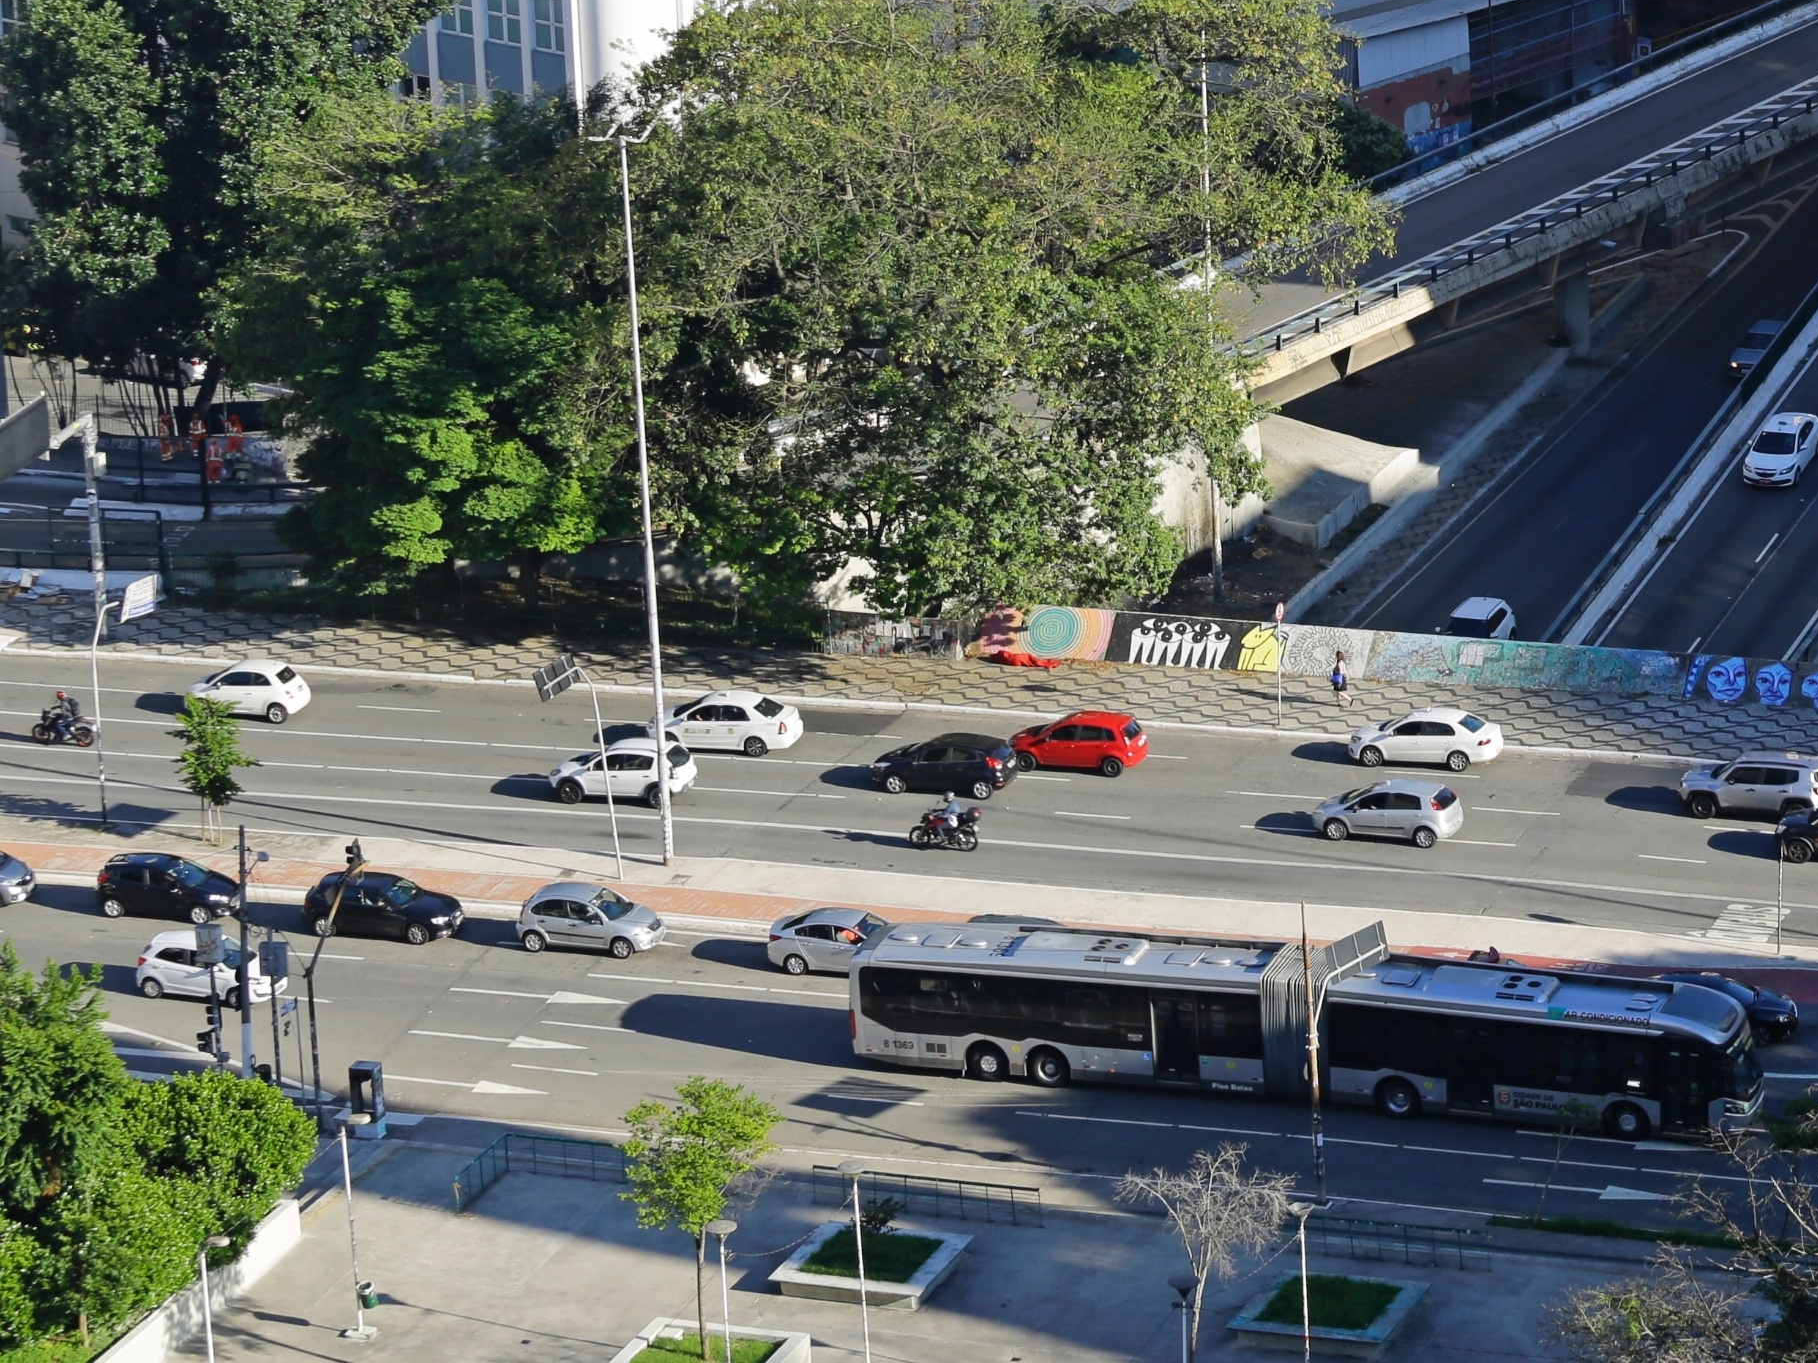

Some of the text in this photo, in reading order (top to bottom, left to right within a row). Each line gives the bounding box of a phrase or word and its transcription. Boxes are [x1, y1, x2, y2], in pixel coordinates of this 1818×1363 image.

[1564, 1010, 1650, 1027] AR CONDICIONADO
[883, 1039, 914, 1049] 8 1369
[1211, 1082, 1253, 1091] Piso Baixo
[1513, 1091, 1554, 1102] CIDADE DE
